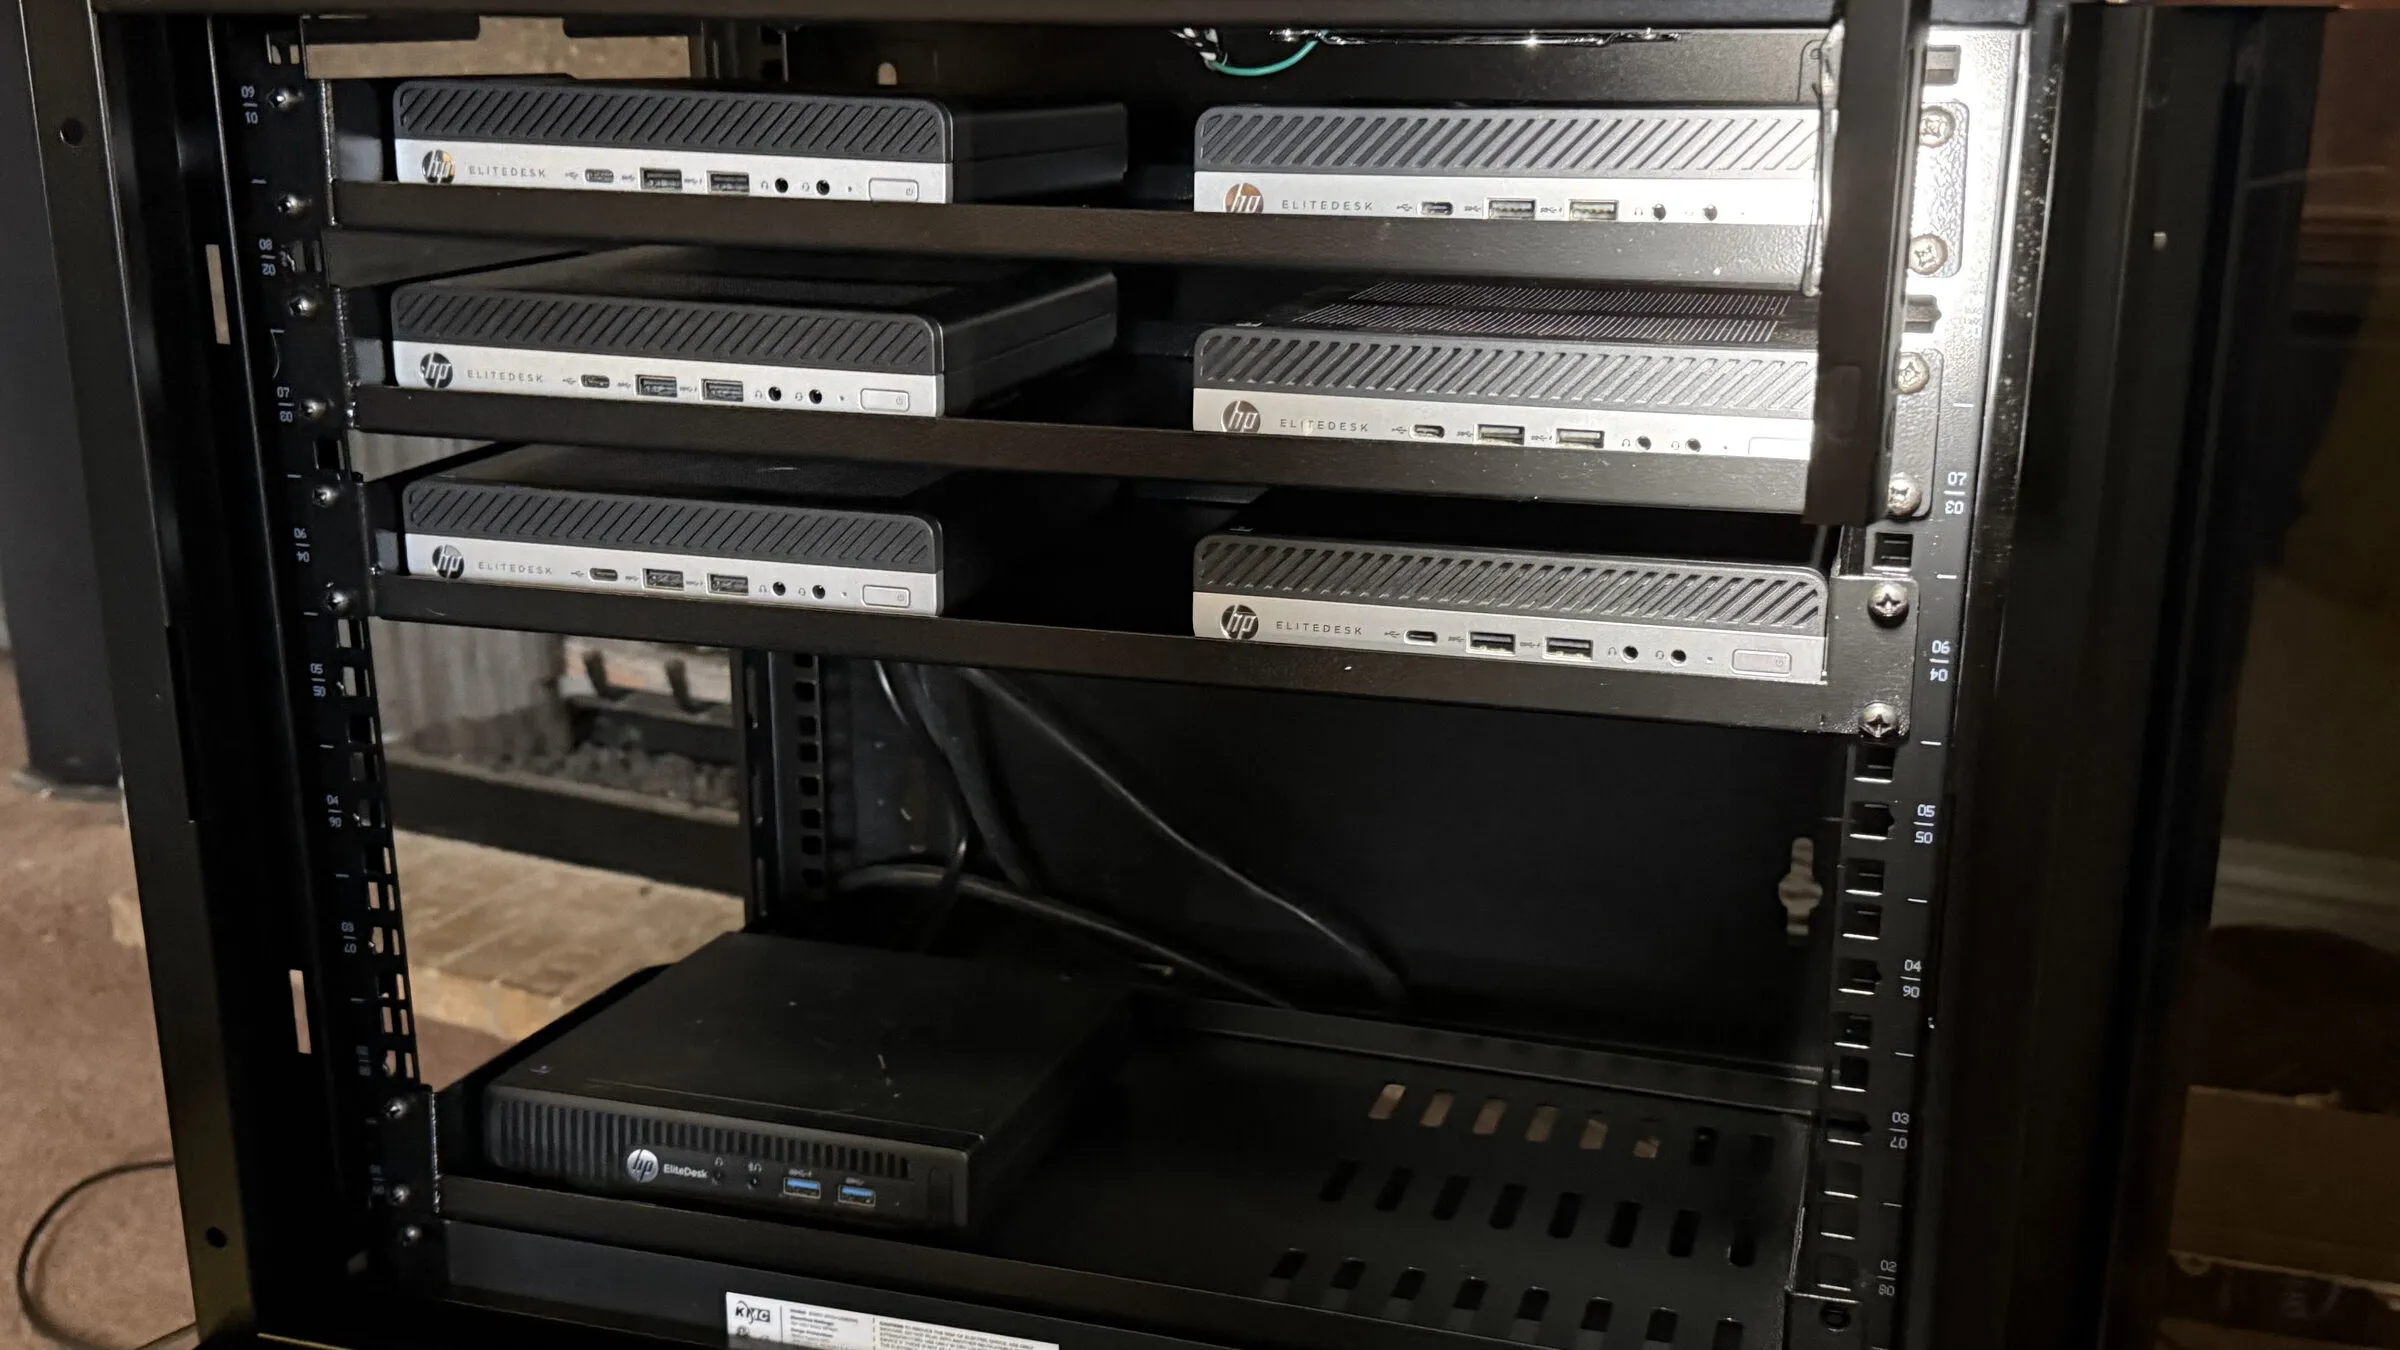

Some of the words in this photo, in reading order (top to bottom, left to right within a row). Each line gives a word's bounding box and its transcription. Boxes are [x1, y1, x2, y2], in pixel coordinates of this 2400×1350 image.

[241, 85, 255, 98] 09
[422, 149, 456, 184] hp
[468, 165, 546, 177] ELITEDESK
[1224, 183, 1264, 214] hp
[1281, 200, 1374, 211] ELITEDESK
[420, 352, 454, 389] hp
[466, 369, 544, 383] ELITEDESK
[276, 386, 290, 399] 07
[1221, 400, 1261, 434] hp
[1279, 419, 1369, 432] ELITEDESK
[1946, 471, 1968, 487] 07
[432, 544, 465, 580] hp
[477, 561, 553, 575] ELITEDESK
[1220, 604, 1259, 640] hp
[1276, 621, 1363, 635] ELITEDESK
[1931, 640, 1951, 654] 06
[310, 663, 324, 674] 05
[326, 794, 339, 806] 04
[1916, 804, 1936, 817] 05
[1904, 959, 1922, 972] 04
[1891, 1112, 1910, 1125] 03
[627, 1148, 660, 1183] hp
[663, 1163, 708, 1179] EliteDesk
[1880, 1260, 1897, 1272] 02
